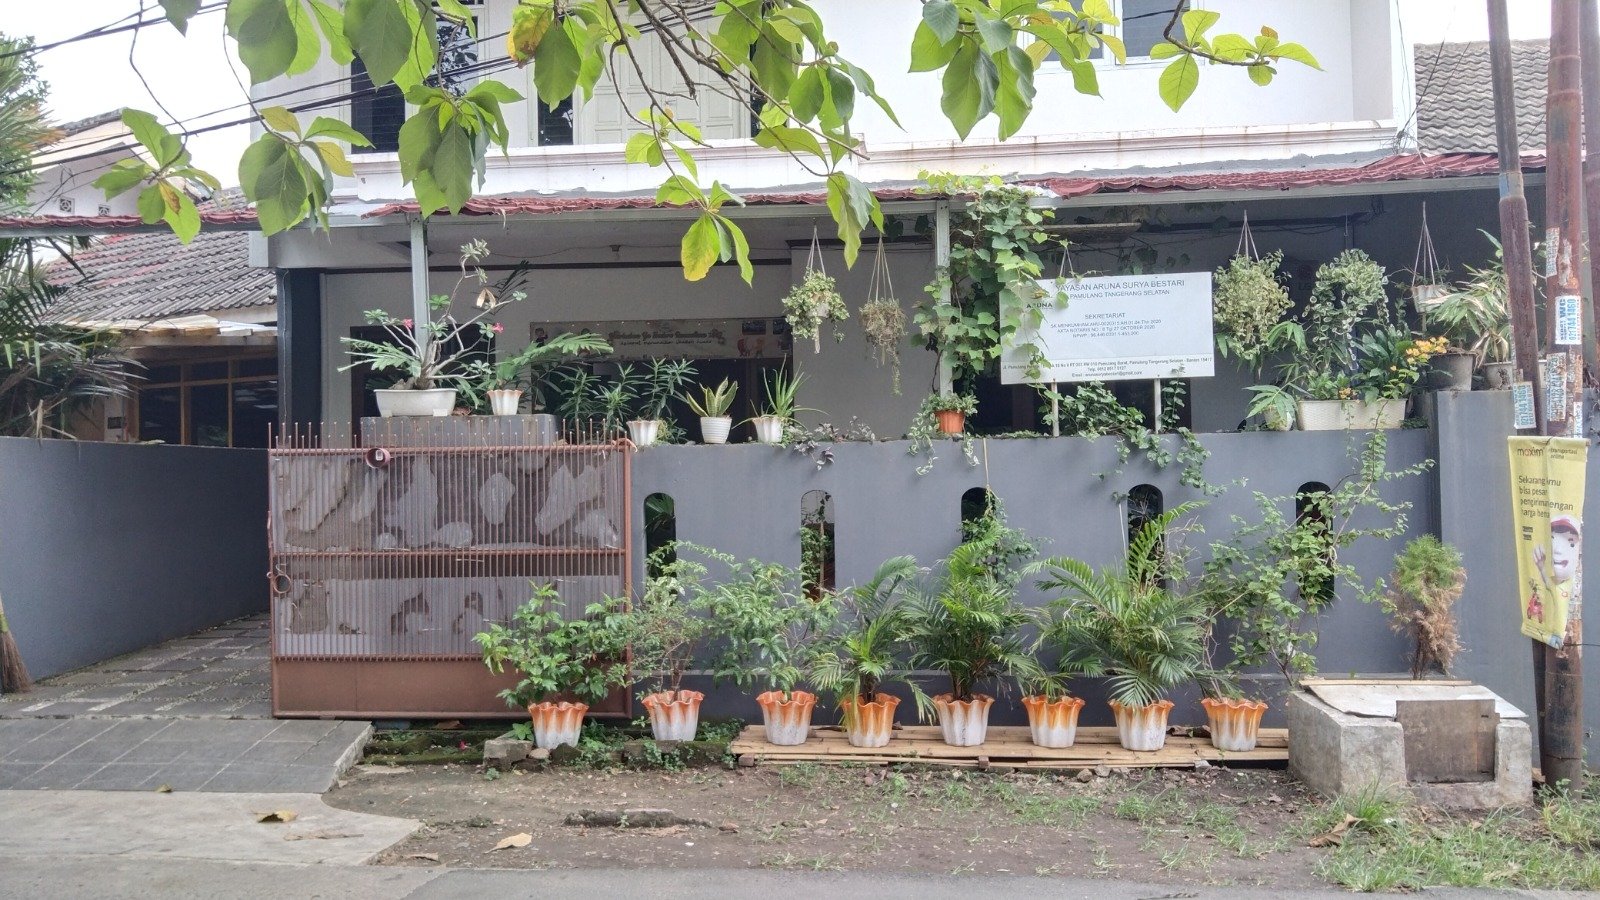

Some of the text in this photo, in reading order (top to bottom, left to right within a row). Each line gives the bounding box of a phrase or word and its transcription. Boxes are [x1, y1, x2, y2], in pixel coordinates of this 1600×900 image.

[1093, 282, 1120, 290] ARUNA
[1122, 281, 1149, 289] SURYA
[1150, 279, 1185, 288] BESTARI
[1104, 290, 1142, 298] TANGERANG
[1084, 312, 1126, 320] SEKRETARIAT
[1517, 446, 1544, 457] maxim
[1518, 475, 1546, 487] Sekarang
[1519, 485, 1531, 495] bisa
[1549, 501, 1574, 512] engan
